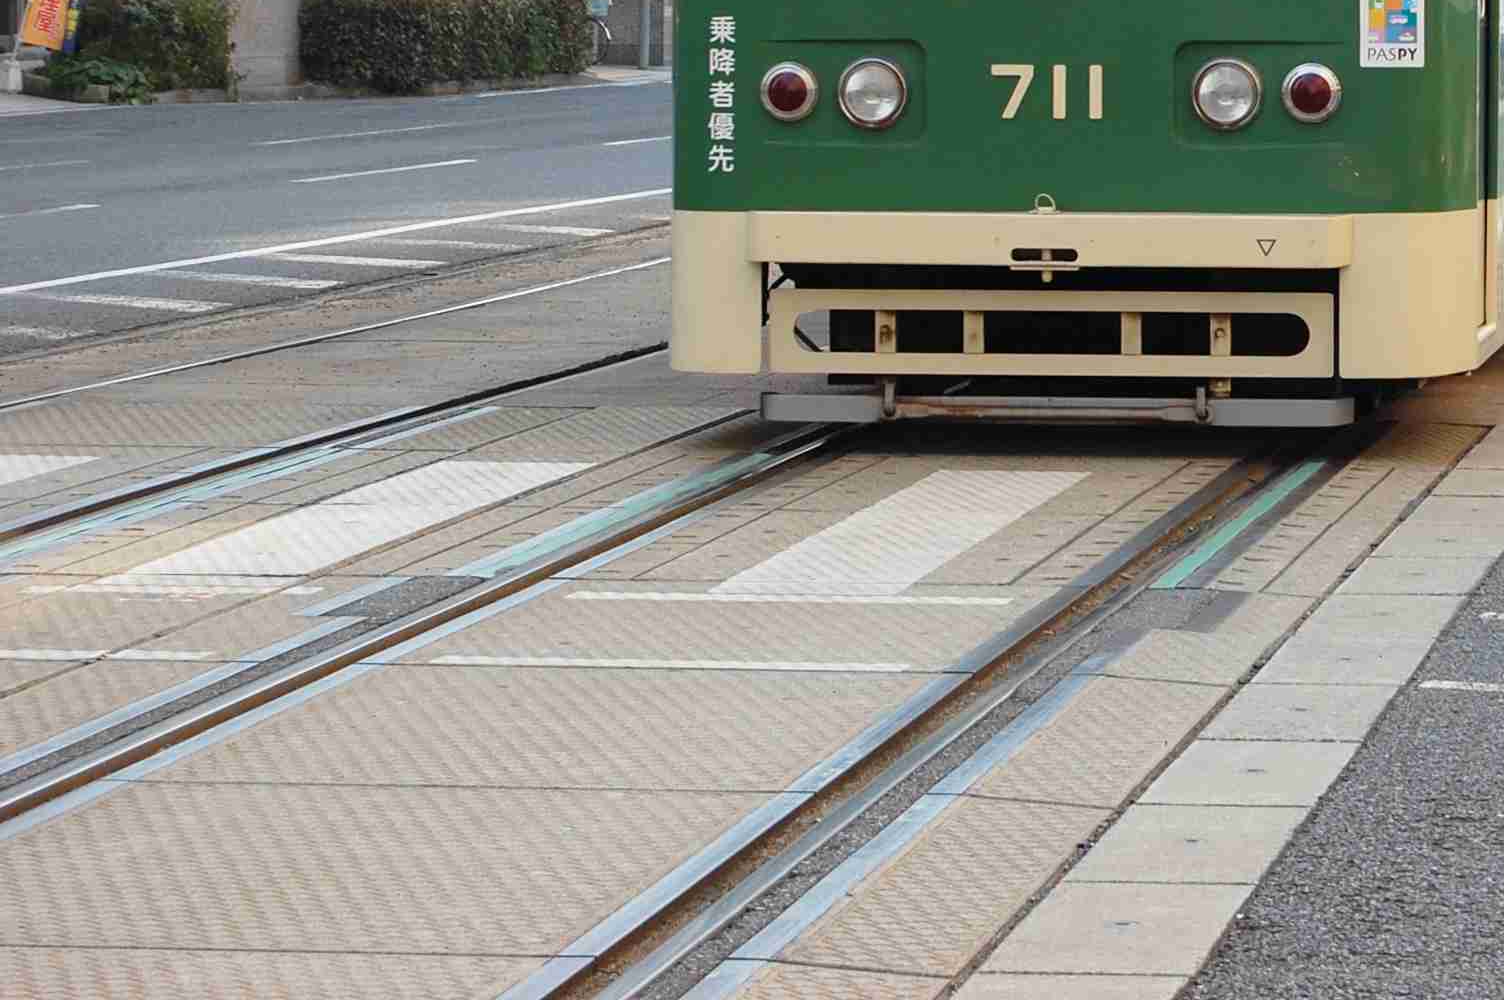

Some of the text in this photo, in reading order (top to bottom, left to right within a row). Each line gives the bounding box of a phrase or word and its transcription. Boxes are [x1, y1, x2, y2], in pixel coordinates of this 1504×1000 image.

[1367, 46, 1418, 63] PASPY
[707, 15, 736, 173] 乗降者優先
[991, 64, 1104, 120] 711
